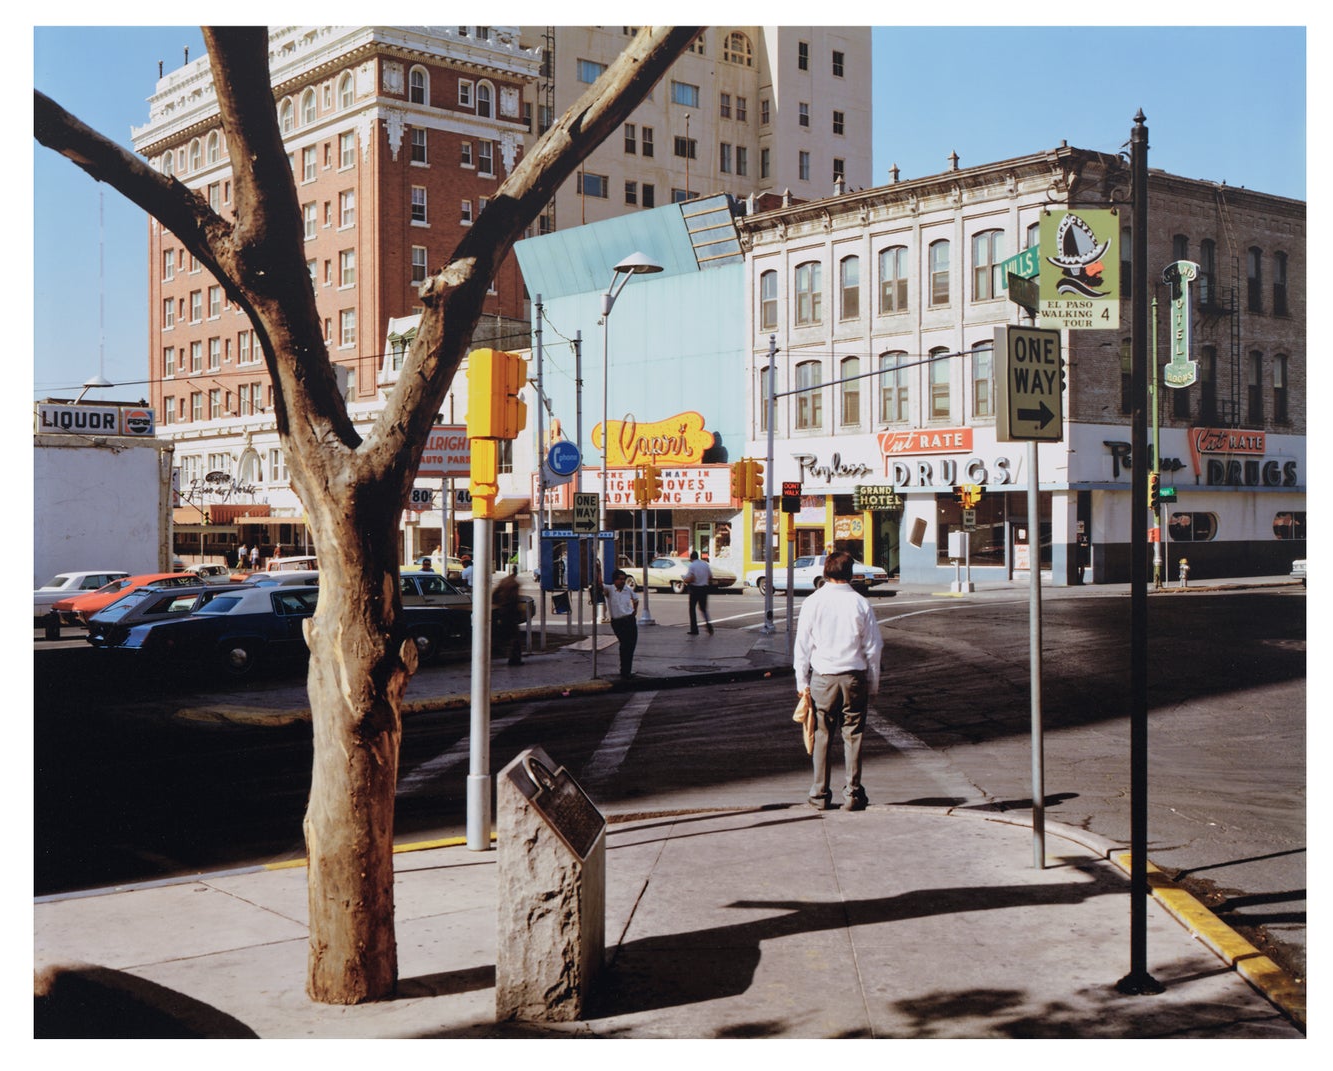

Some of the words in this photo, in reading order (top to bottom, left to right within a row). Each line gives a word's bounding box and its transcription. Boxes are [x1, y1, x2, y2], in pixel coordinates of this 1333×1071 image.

[1005, 253, 1033, 283] MILLS
[1041, 310, 1093, 318] WALKING
[1101, 308, 1110, 321] 4
[1015, 336, 1055, 364] ONE
[1014, 367, 1057, 395] WAY
[42, 411, 114, 429] LIQUOR
[620, 413, 694, 465] Capri
[881, 433, 918, 453] Cut
[920, 433, 963, 448] RATE
[1229, 436, 1263, 449] RATE
[559, 454, 578, 463] phone
[791, 453, 874, 484] Payless
[892, 457, 1011, 487] DRUGS
[1207, 459, 1298, 487] DRUGS
[606, 480, 635, 490] IGH
[661, 480, 705, 490] OVES
[577, 496, 596, 505] ONE
[605, 492, 631, 503] ADY
[695, 492, 713, 502] FU
[861, 495, 901, 505] HOTEL
[576, 508, 596, 517] WAY
